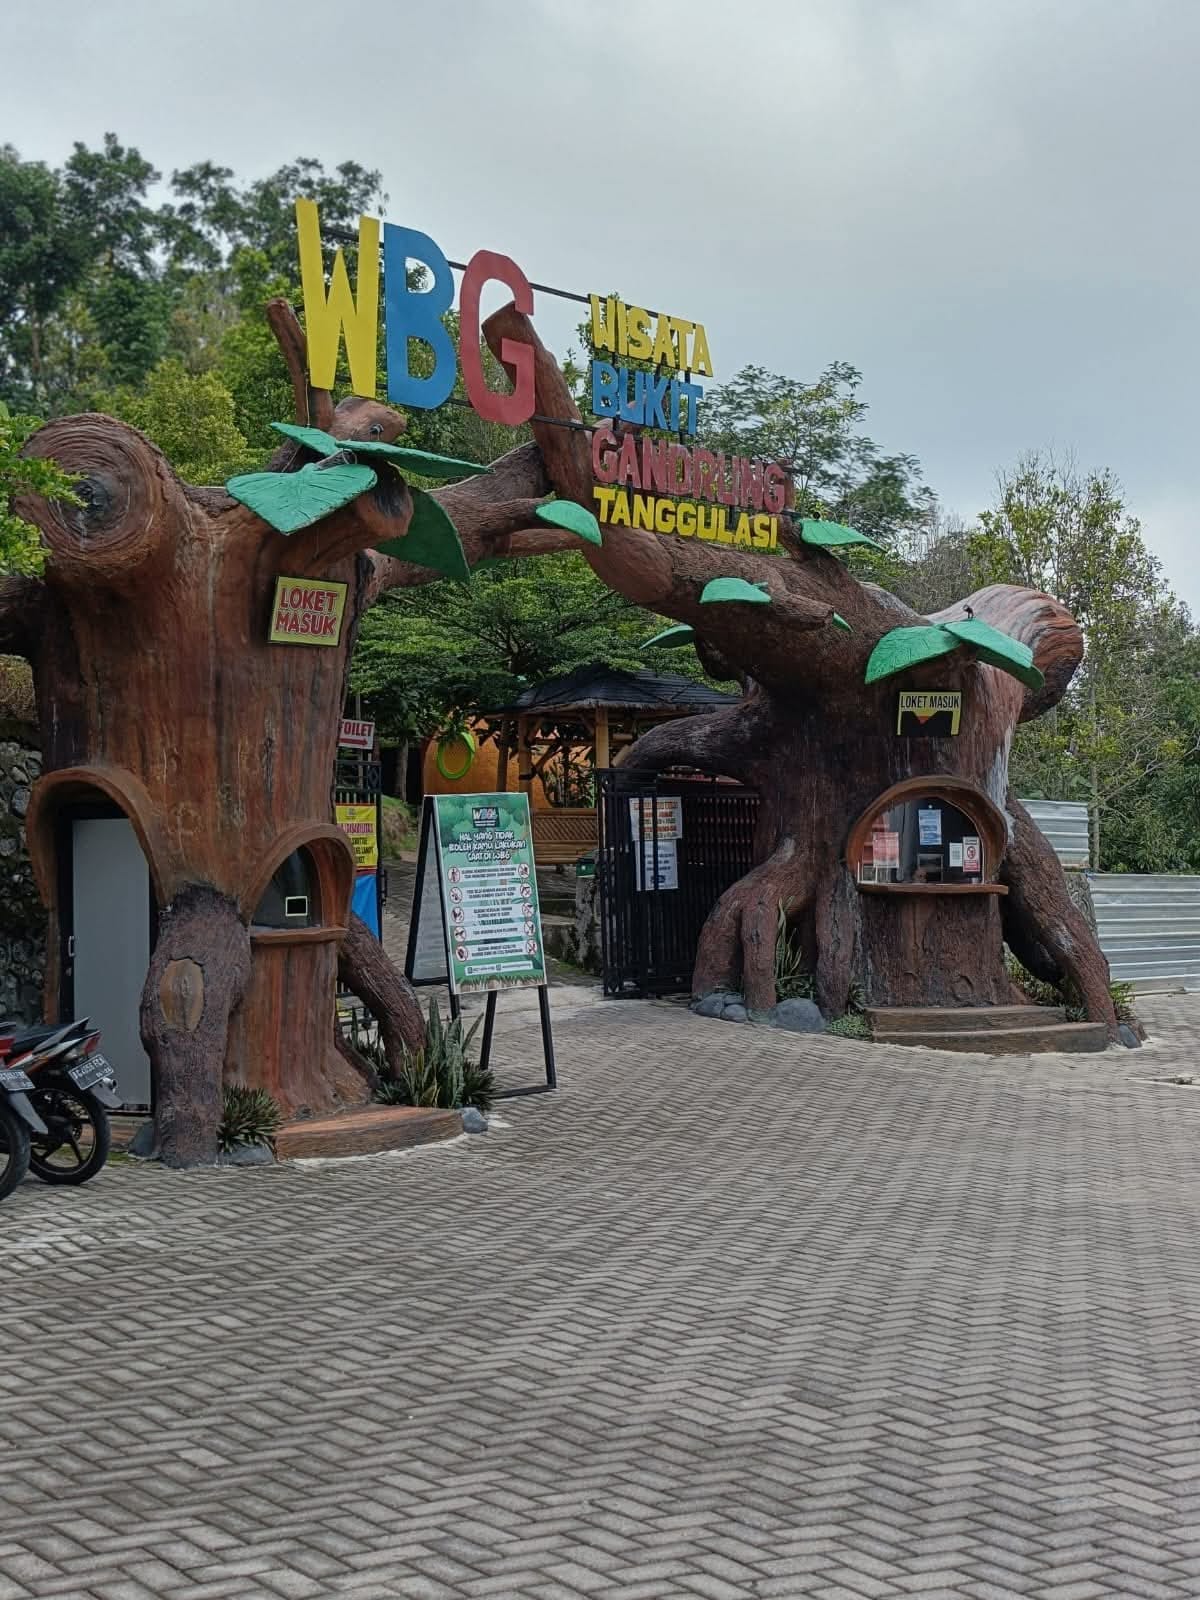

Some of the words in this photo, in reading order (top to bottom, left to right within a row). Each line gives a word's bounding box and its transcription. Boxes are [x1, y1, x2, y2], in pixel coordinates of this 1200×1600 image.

[296, 198, 536, 426] WBG
[590, 294, 713, 378] WISATA
[591, 360, 703, 436] BUKIT
[592, 428, 785, 514] GANDRUNG
[593, 486, 778, 549] TANGGULASI
[275, 610, 337, 635] MASUK
[280, 587, 338, 612] LOKET
[900, 695, 927, 708] LOKET
[929, 695, 960, 709] MASUK
[495, 831, 515, 841] TIDAK
